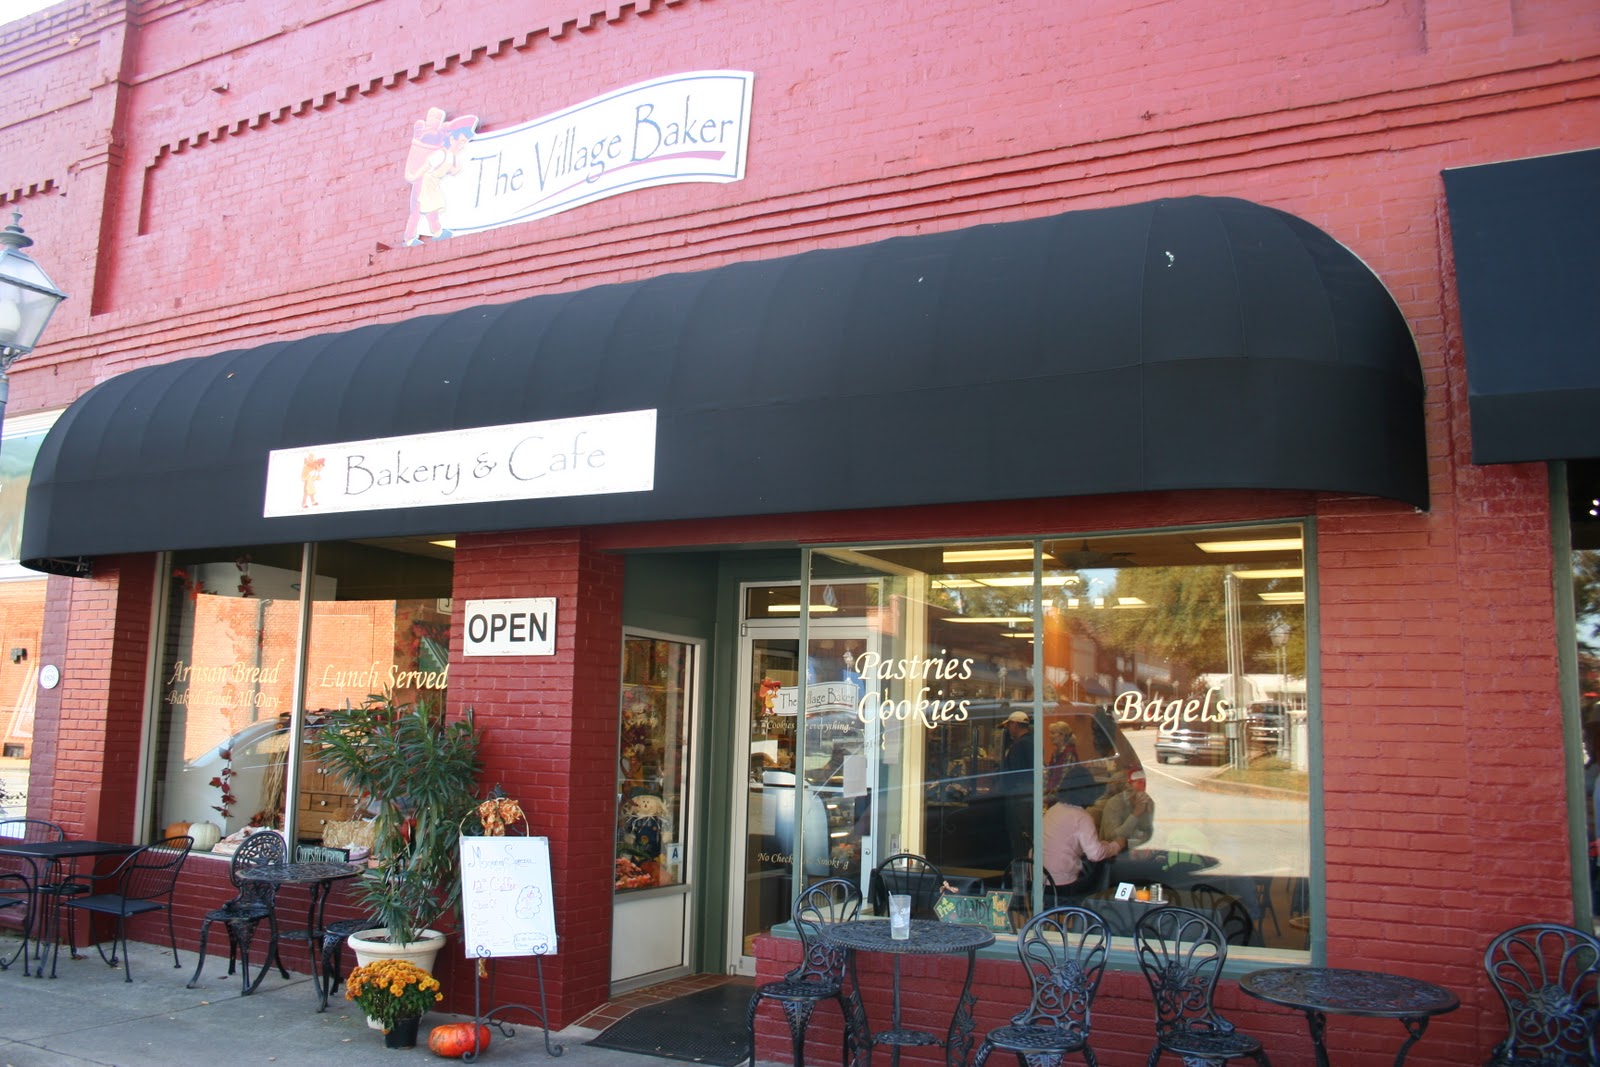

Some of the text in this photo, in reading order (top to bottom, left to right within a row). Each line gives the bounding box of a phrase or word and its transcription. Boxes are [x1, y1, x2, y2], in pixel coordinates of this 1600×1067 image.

[469, 94, 733, 208] The Village Baker
[344, 431, 606, 495] Bakery & Cafe
[468, 612, 548, 643] OPEN
[167, 658, 284, 685] Artisan Bread
[317, 661, 450, 690] Lunch Served
[855, 648, 974, 680] Pastries
[203, 689, 232, 706] Fresh
[232, 689, 255, 709] All
[780, 687, 854, 709] The llage Baker
[858, 686, 971, 729] Cookies
[1113, 685, 1230, 734] Bagels
[672, 847, 678, 859] A
[757, 853, 769, 862] No
[1120, 887, 1127, 897] 6
[956, 899, 992, 922] CANDY
